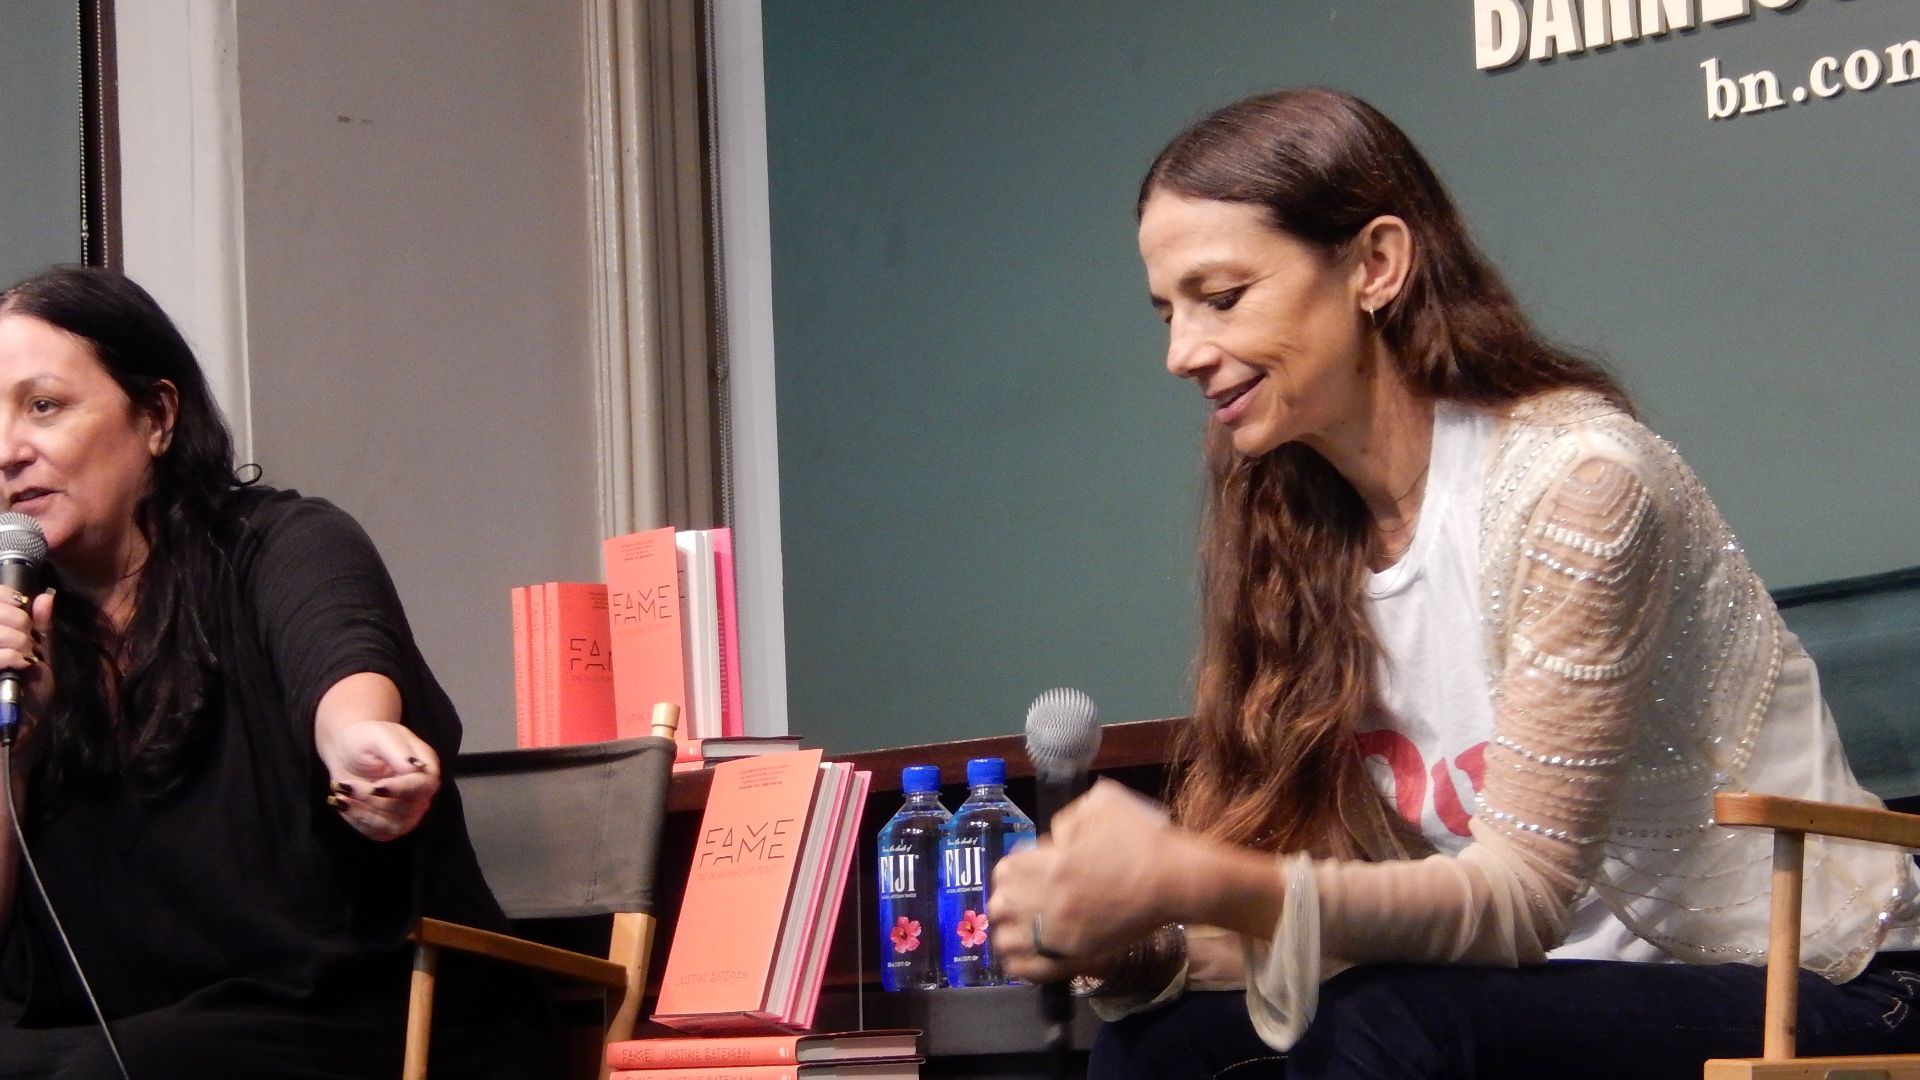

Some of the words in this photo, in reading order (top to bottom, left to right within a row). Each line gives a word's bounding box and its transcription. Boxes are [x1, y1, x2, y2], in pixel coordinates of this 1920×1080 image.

[612, 584, 673, 627] FAME
[570, 638, 613, 671] FA
[699, 818, 795, 869] FAME
[880, 854, 916, 894] FIJI
[945, 846, 983, 888] FIJI
[664, 1049, 701, 1062] JUSTINE
[704, 1047, 752, 1061] BATEMAN
